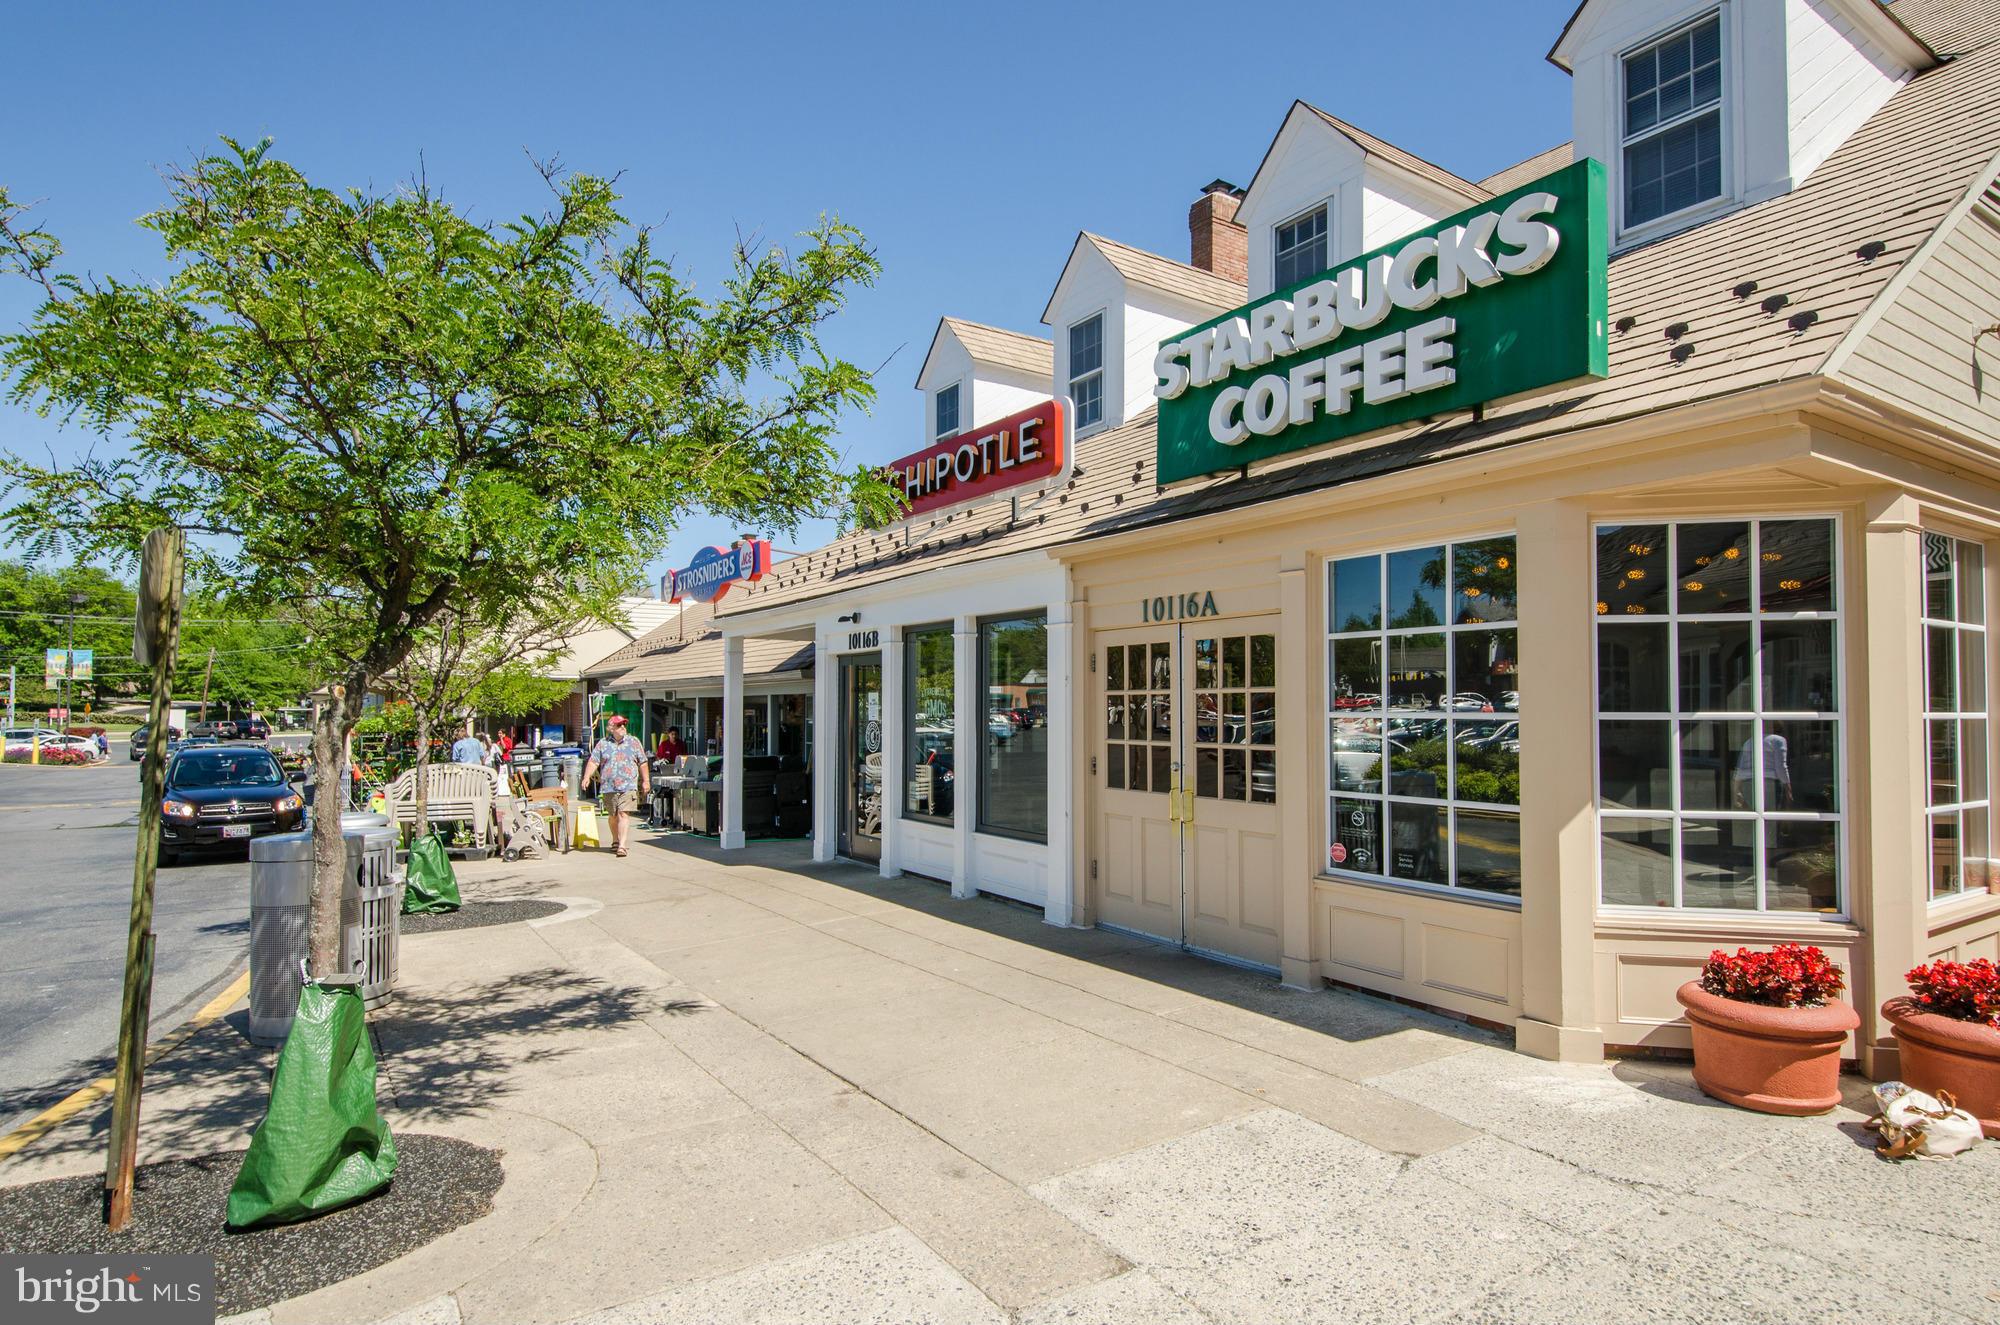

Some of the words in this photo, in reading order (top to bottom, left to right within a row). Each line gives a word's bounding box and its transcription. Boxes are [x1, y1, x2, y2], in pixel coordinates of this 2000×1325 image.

[1154, 192, 1560, 400] STARBUCKS
[1209, 316, 1456, 446] COFFEE
[677, 555, 736, 592] STROSNIDERS
[1143, 591, 1219, 623] 10116A
[848, 630, 879, 650] 10116B
